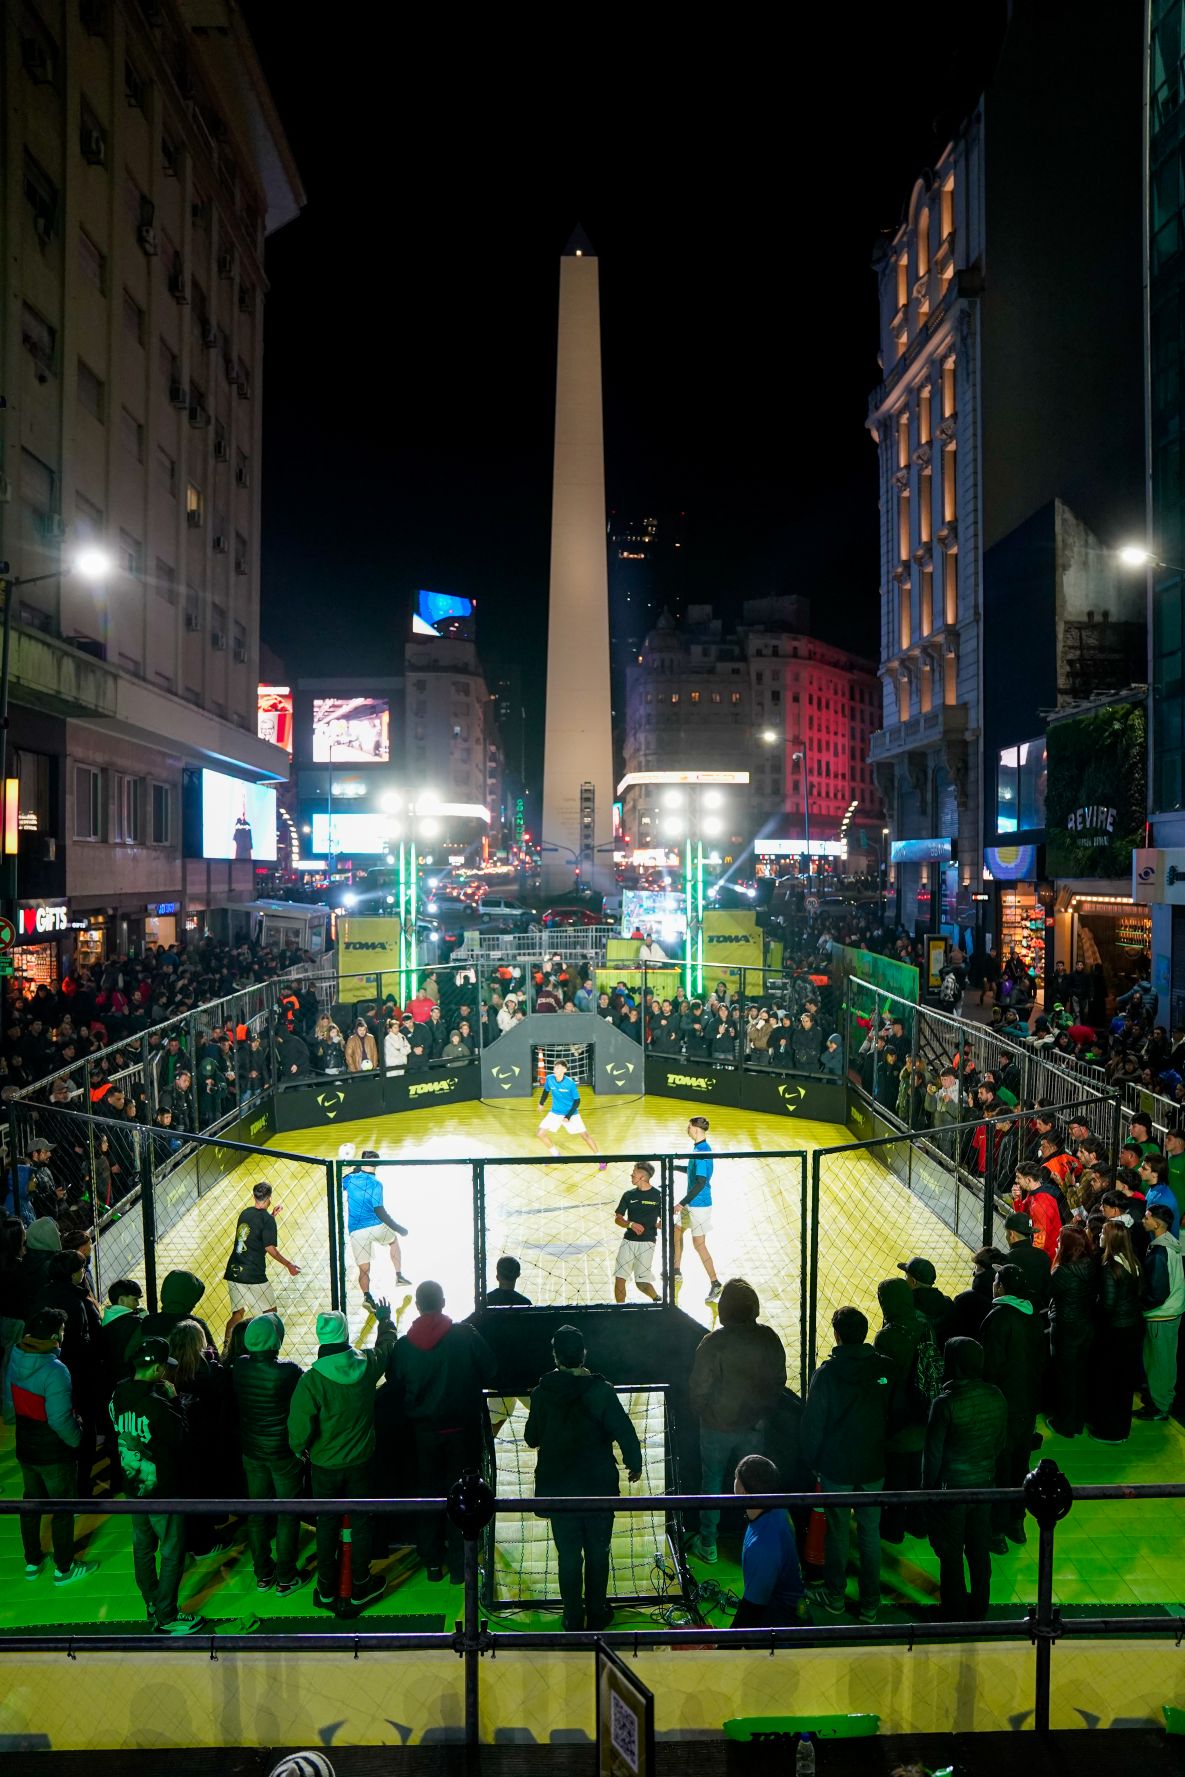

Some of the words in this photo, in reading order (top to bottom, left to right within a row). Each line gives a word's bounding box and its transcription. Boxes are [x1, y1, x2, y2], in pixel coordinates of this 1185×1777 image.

[708, 935, 750, 943] TOMA
[344, 942, 387, 950] TOMA
[667, 1074, 707, 1087] TOMA
[408, 1080, 449, 1095] TOMA
